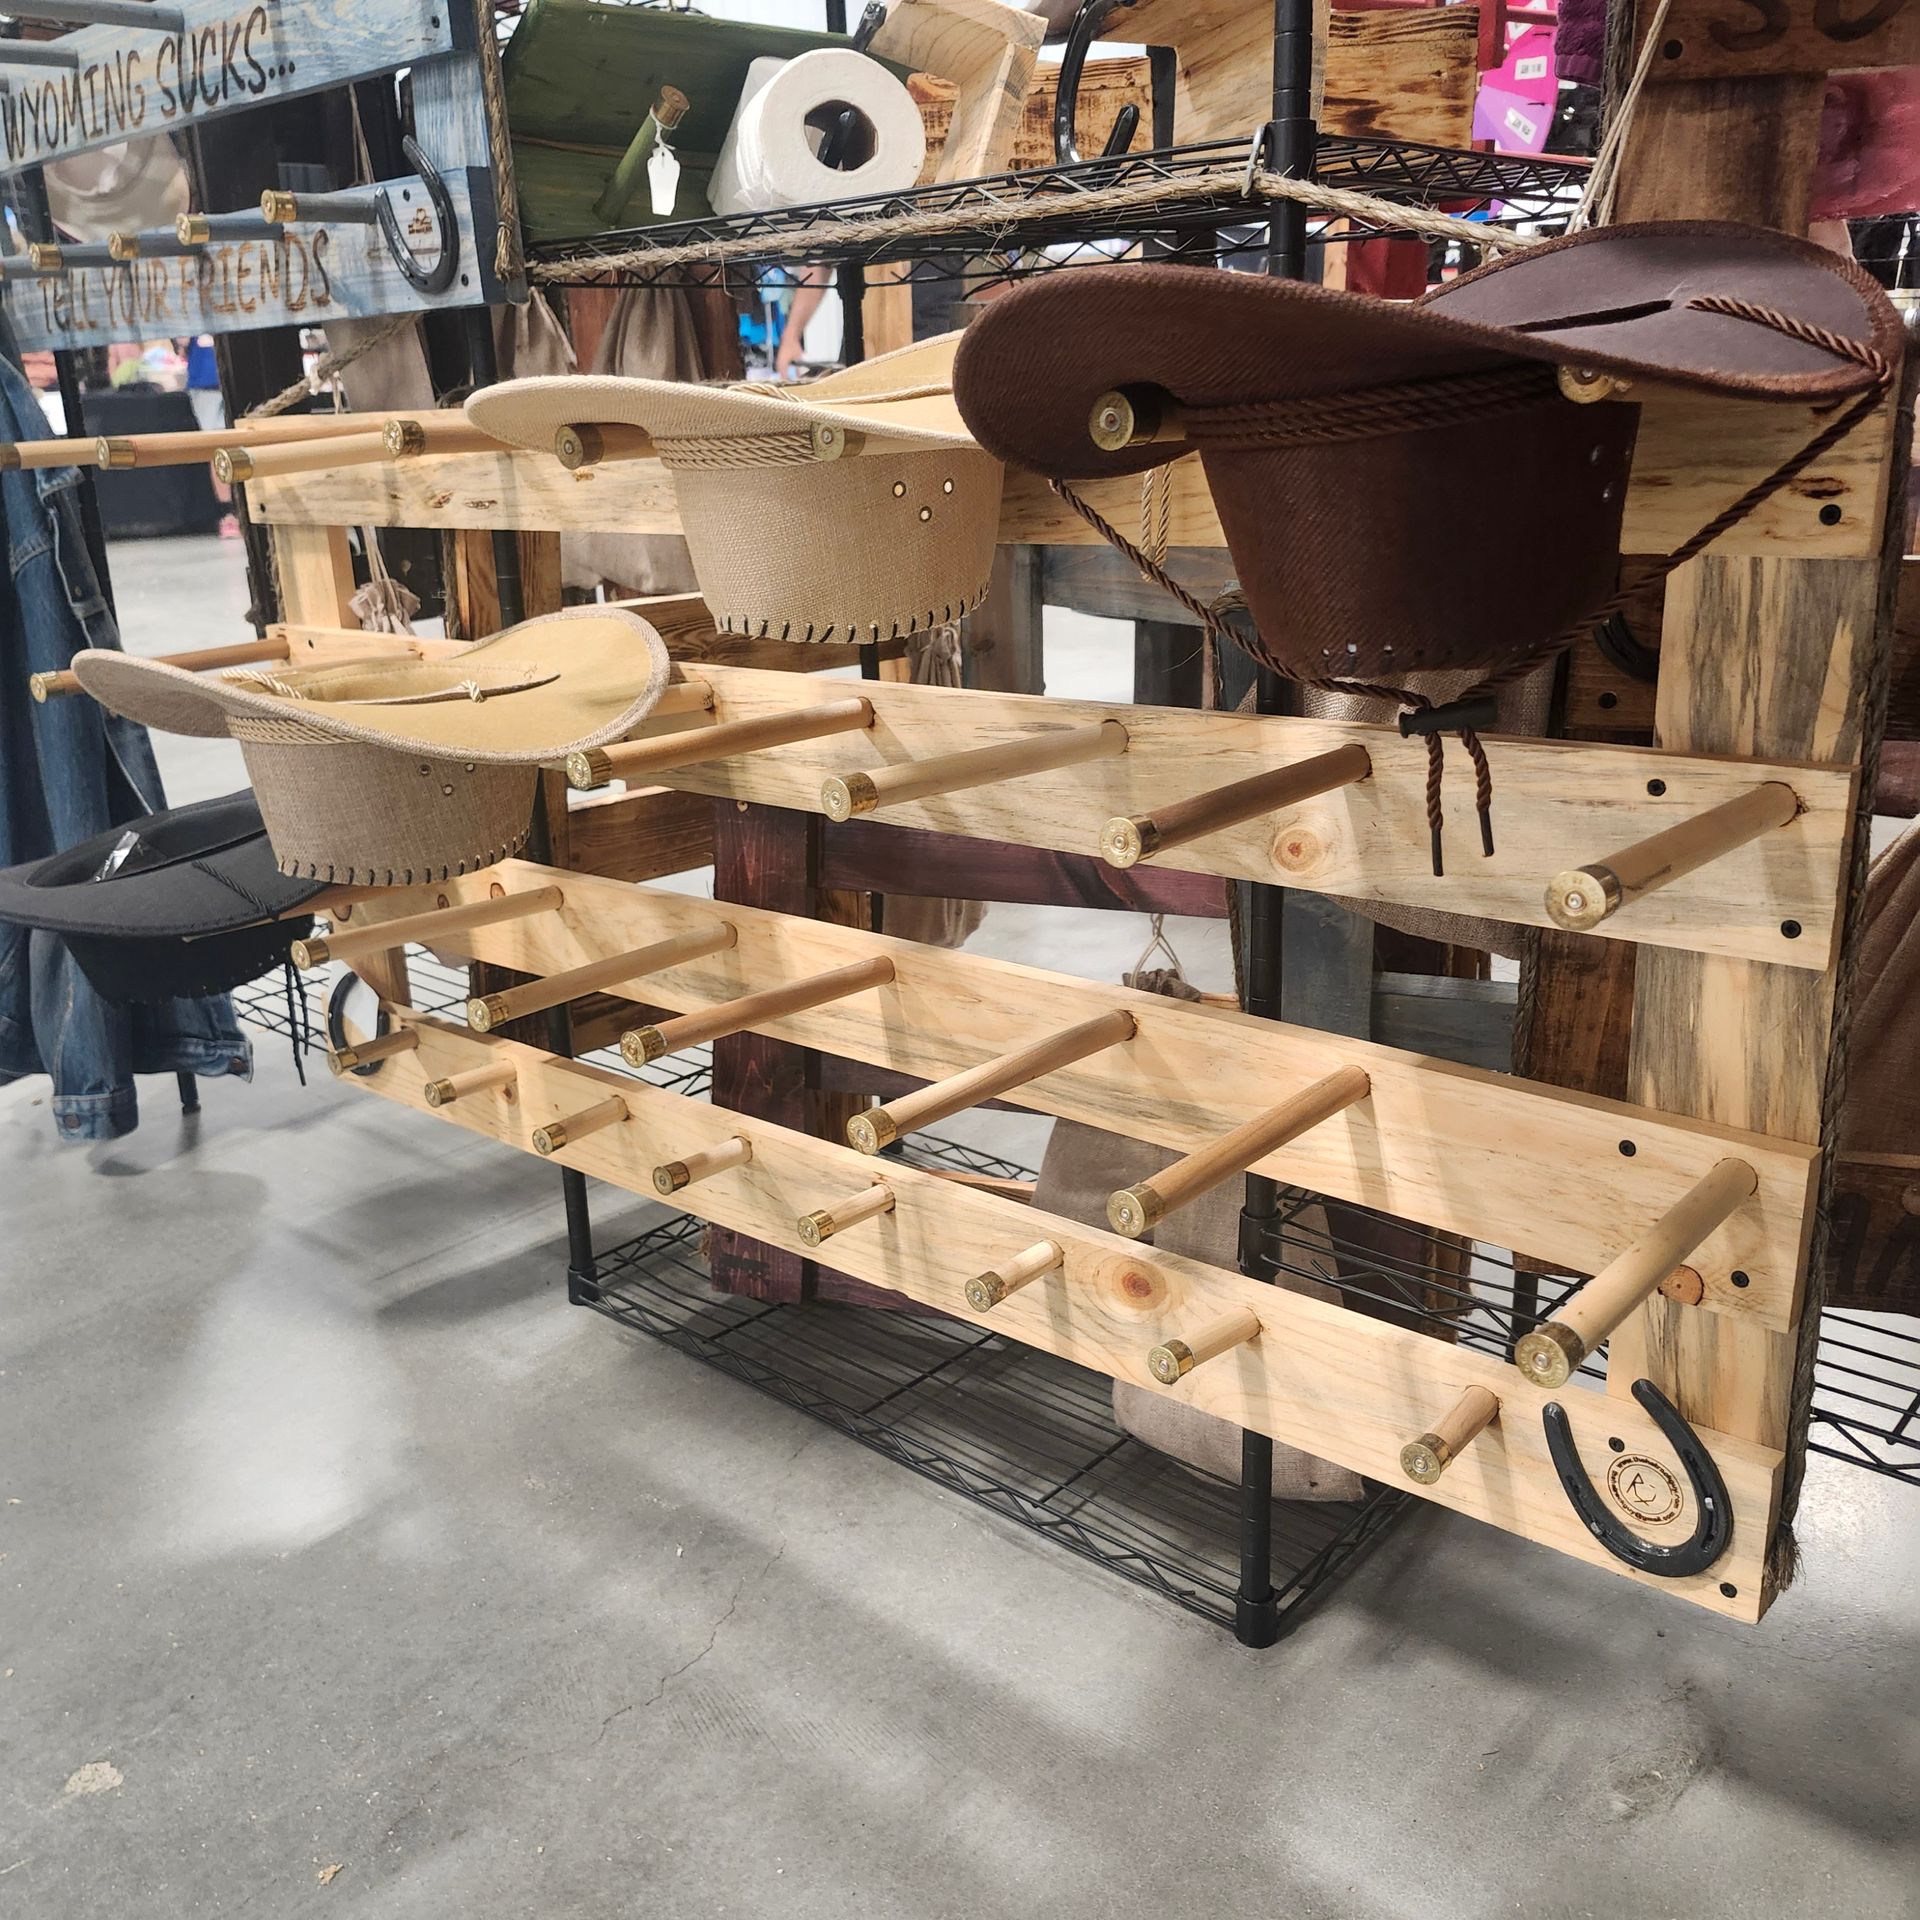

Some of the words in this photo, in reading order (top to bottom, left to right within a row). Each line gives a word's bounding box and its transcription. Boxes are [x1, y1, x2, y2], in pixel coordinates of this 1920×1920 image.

[3, 50, 146, 161] WYOMING
[156, 6, 296, 119] SUCKS...
[36, 270, 98, 334] TELL
[103, 256, 172, 329] YOUR
[177, 229, 331, 316] FRIENDS
